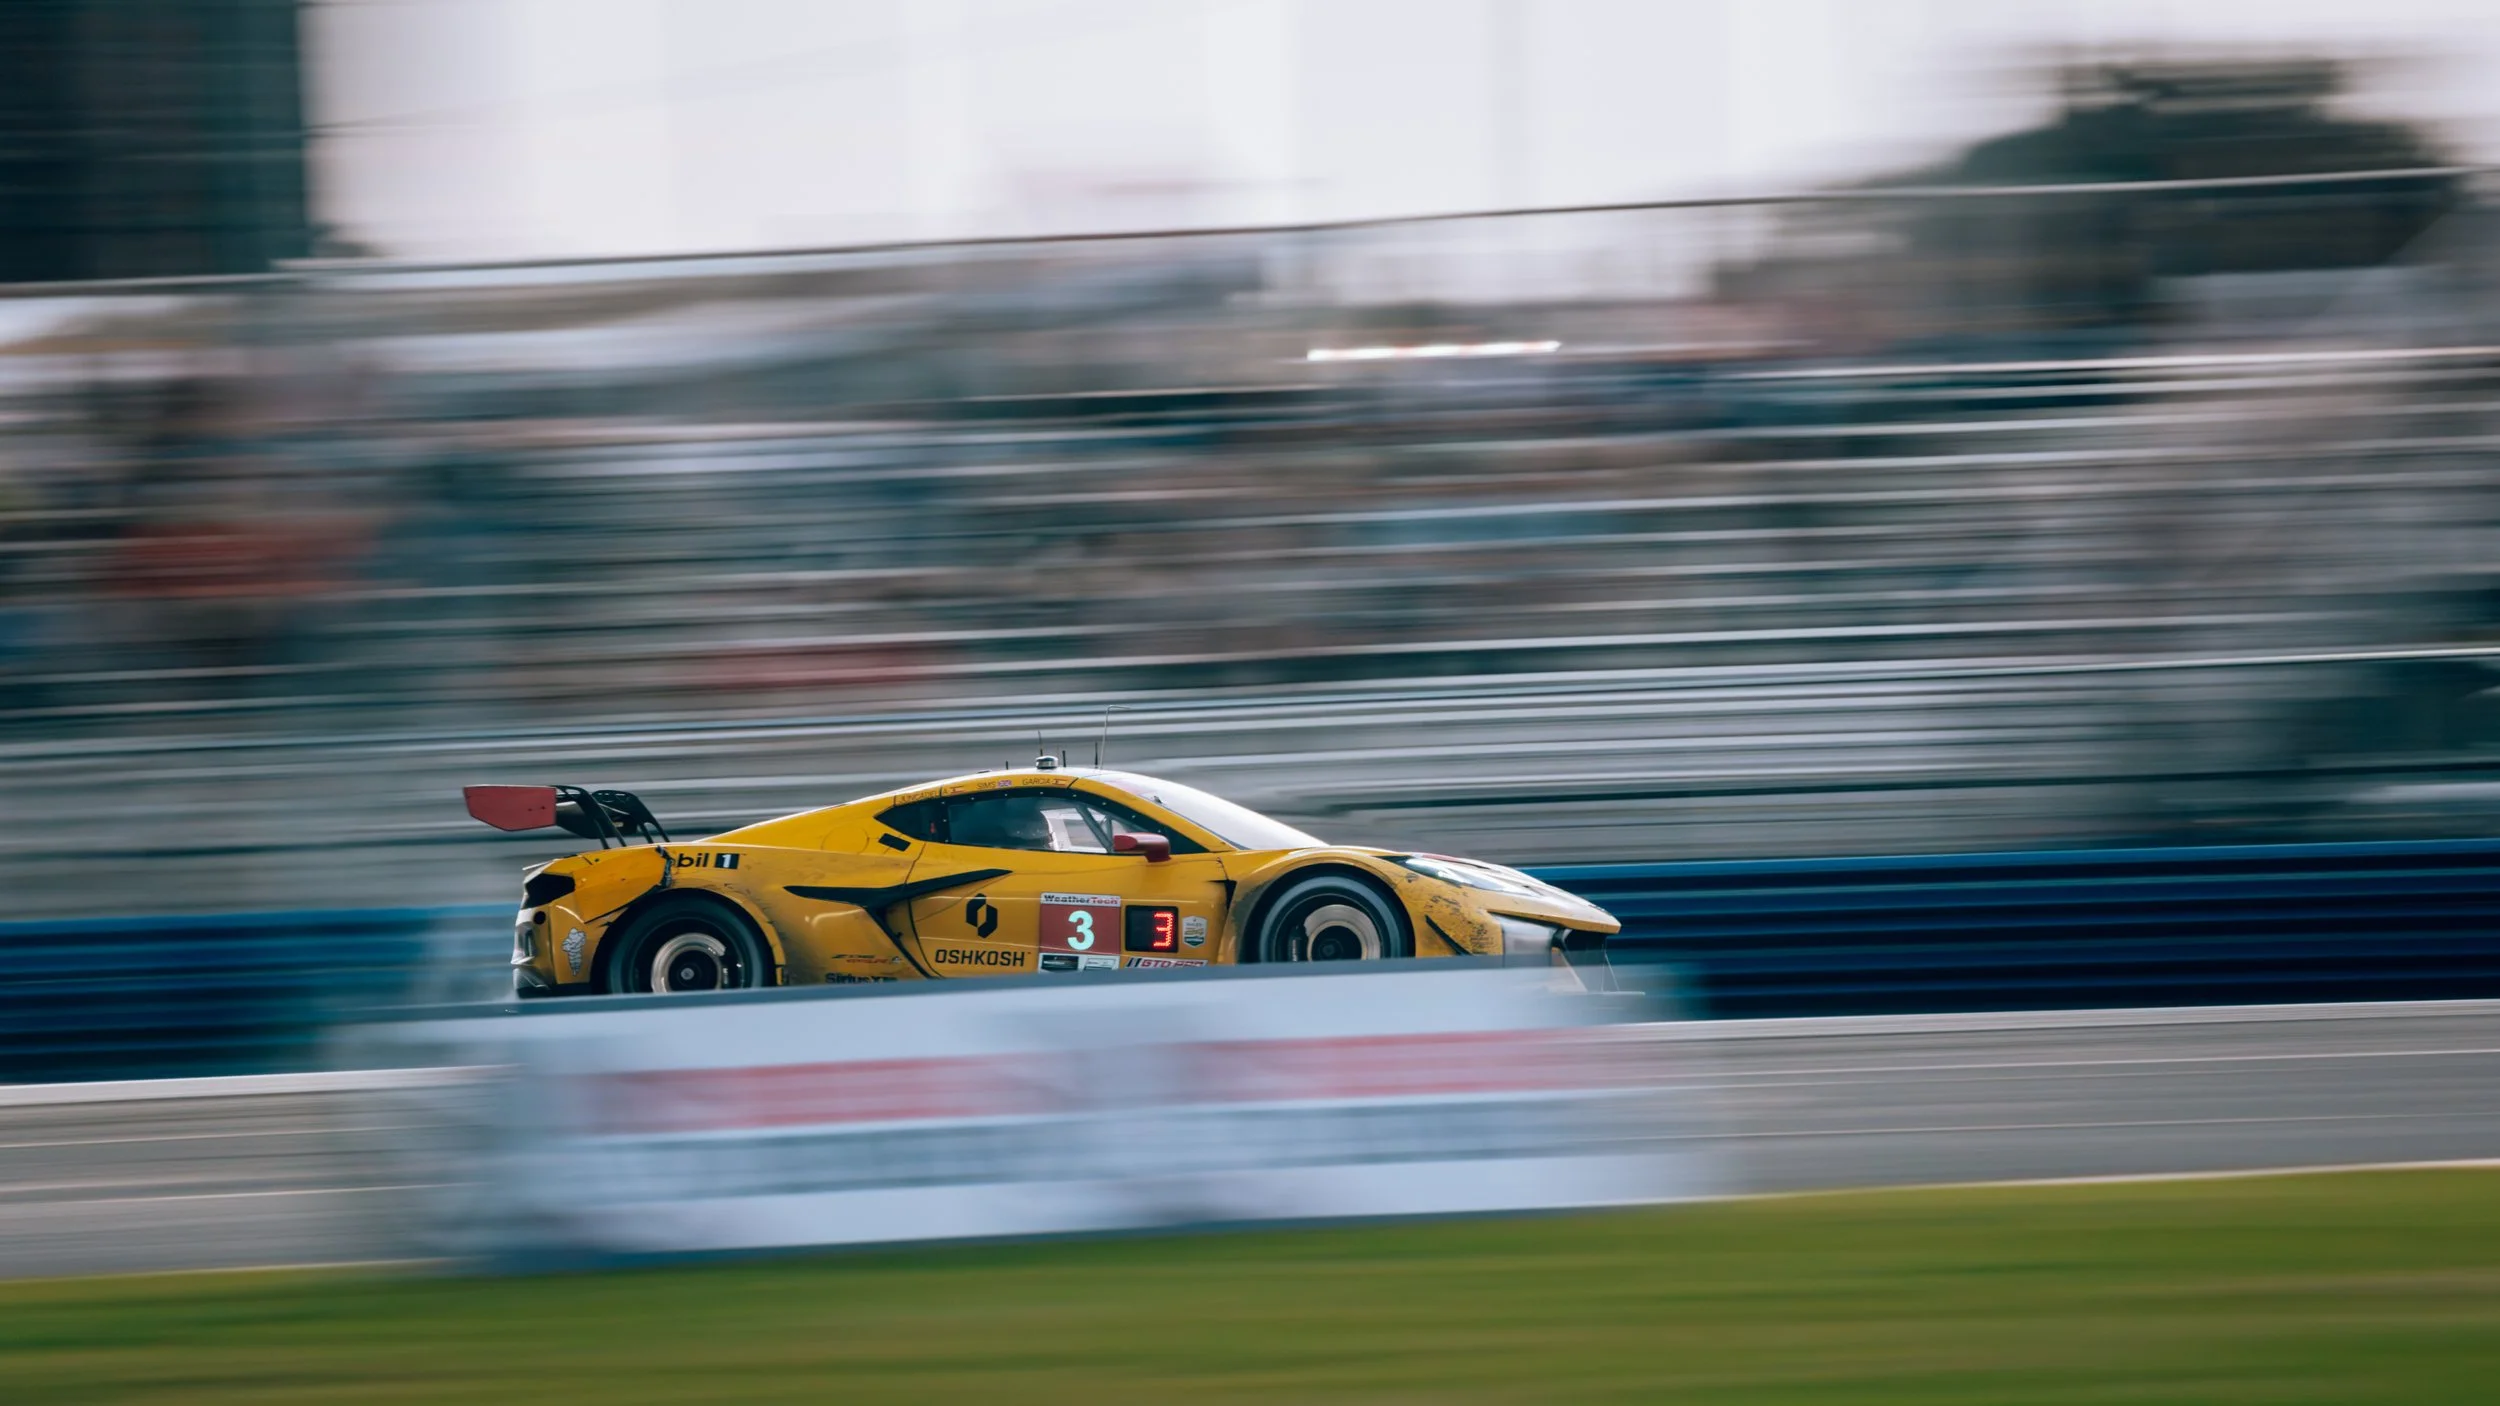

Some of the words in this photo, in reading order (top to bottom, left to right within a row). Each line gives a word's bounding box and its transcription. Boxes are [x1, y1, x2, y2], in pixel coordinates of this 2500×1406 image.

[976, 781, 997, 790] SIMS
[1022, 778, 1051, 786] GARCIA
[1044, 894, 1118, 905] WeatherTech
[1067, 910, 1095, 951] 3
[1153, 911, 1174, 948] 3
[935, 949, 1025, 967] OSHKOSH
